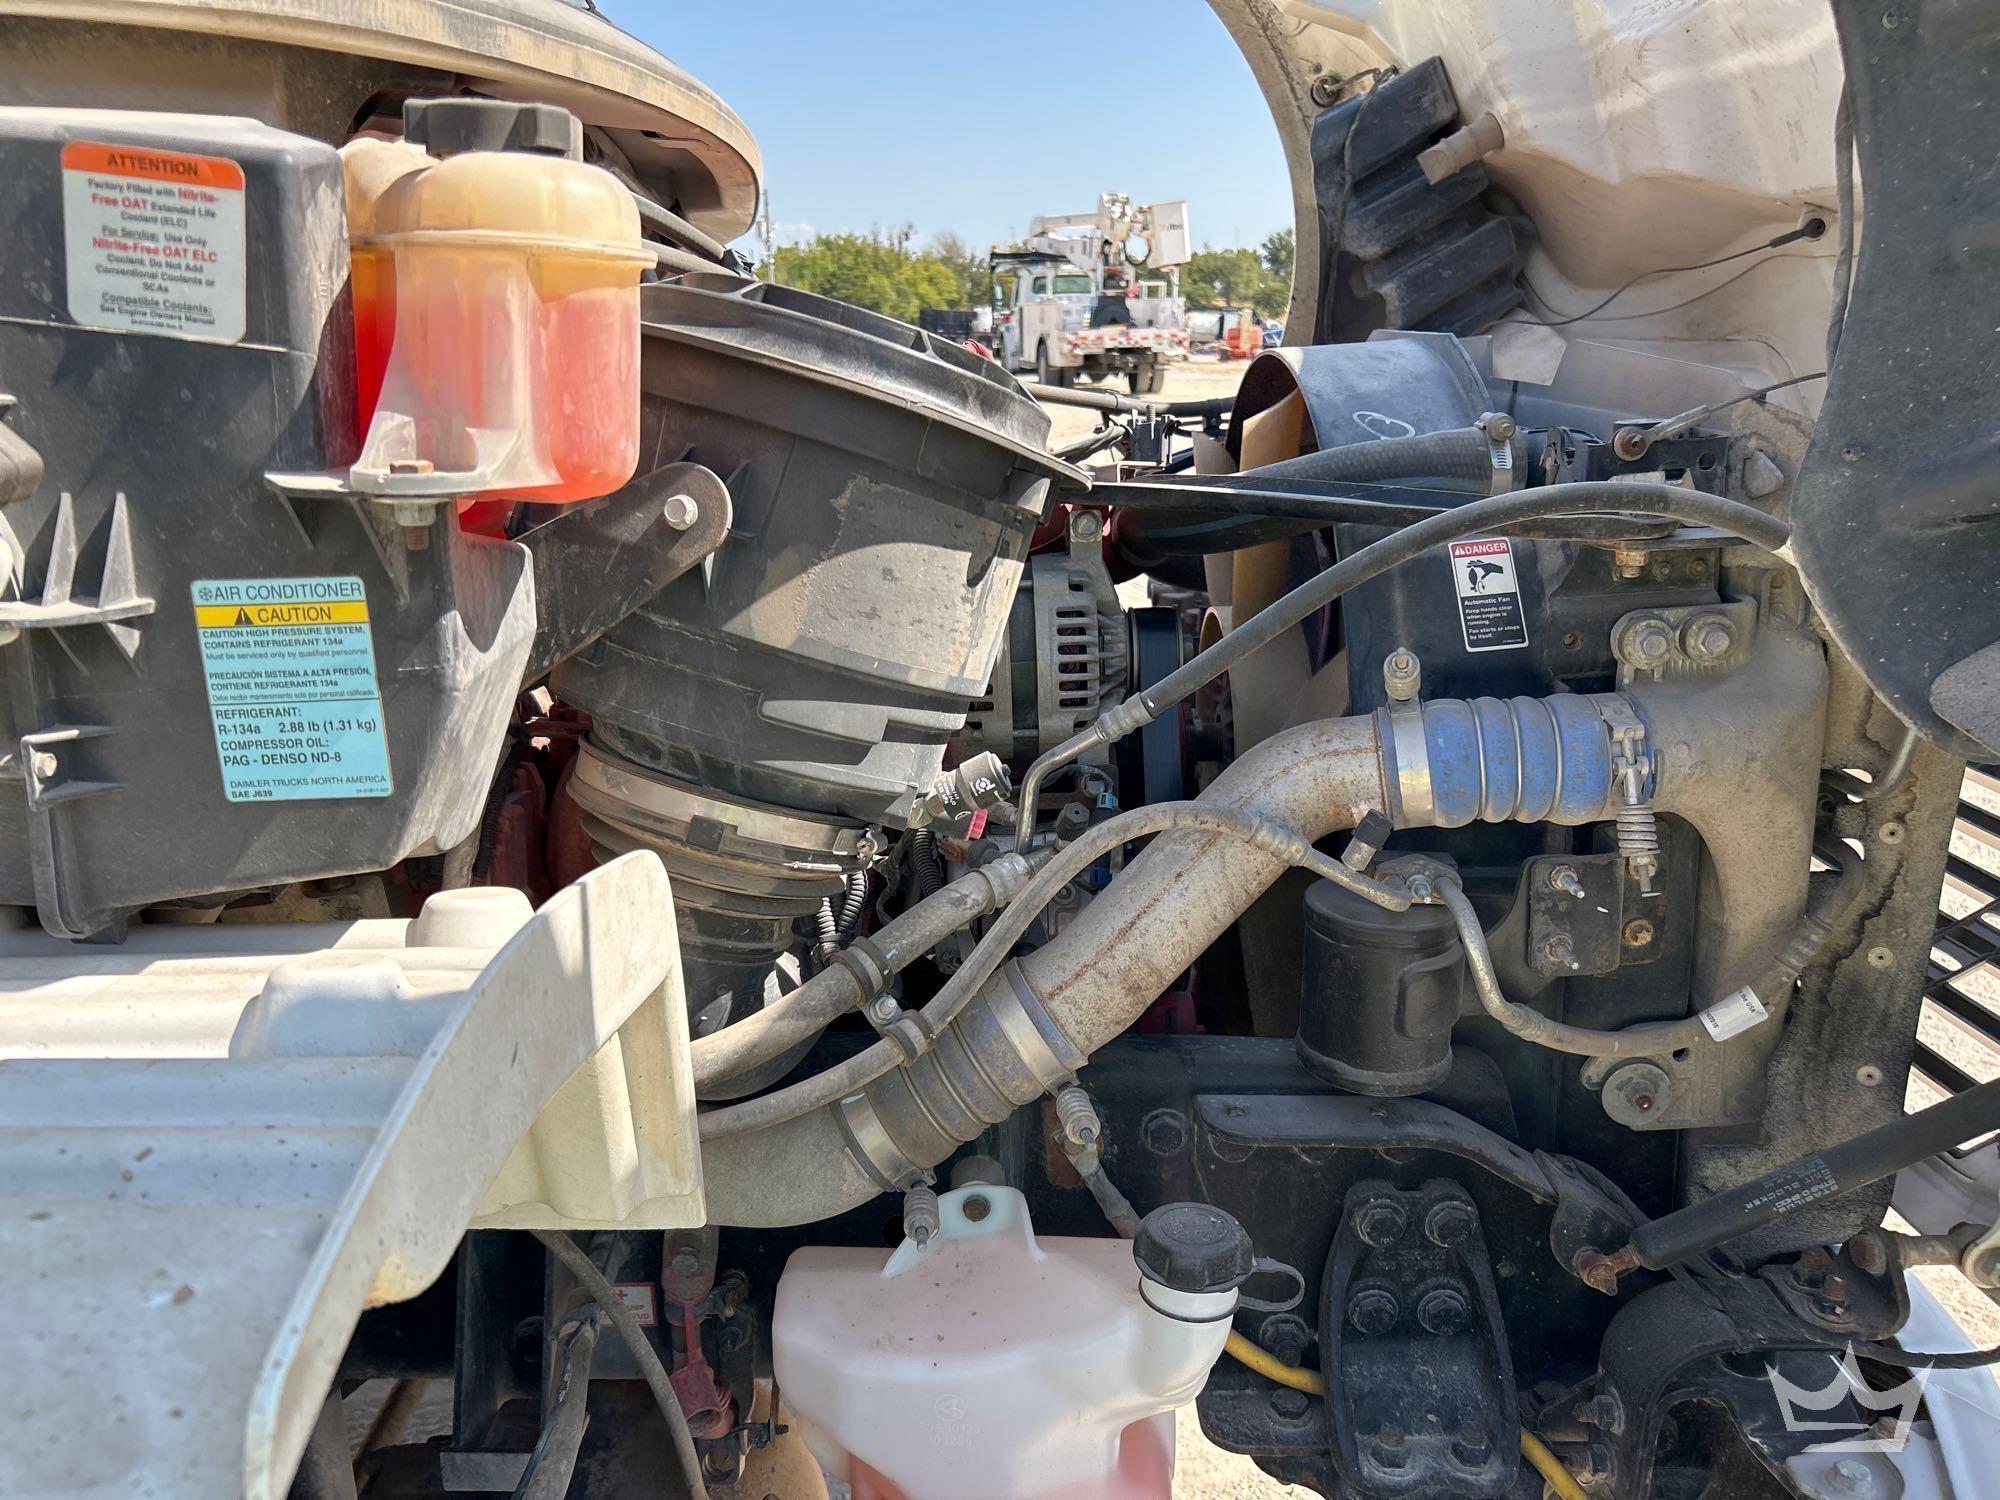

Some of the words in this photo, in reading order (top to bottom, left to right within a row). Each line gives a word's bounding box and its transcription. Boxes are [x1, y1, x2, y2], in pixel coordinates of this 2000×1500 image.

[107, 153, 198, 176] ATTENTION
[88, 178, 124, 194] Factory
[127, 183, 153, 194] Filled
[155, 187, 175, 197] with
[178, 188, 220, 203] Nitrite-
[91, 192, 118, 207] Free
[122, 196, 148, 209] OAT
[151, 202, 195, 216] Extended
[198, 206, 216, 218] Life
[121, 210, 158, 223] Coolant
[161, 215, 187, 230] (ELC)
[102, 225, 117, 236] For
[165, 231, 182, 243] Use
[185, 235, 207, 248] Only
[92, 236, 160, 255] Nitrite-Free
[163, 245, 188, 259] OAT
[192, 249, 218, 263] ELC
[149, 258, 162, 268] Do
[165, 260, 182, 271] Not
[185, 262, 204, 273] Add
[96, 264, 159, 280] Conventional
[161, 271, 203, 285] Coolants
[143, 281, 169, 293] SCAs
[102, 292, 160, 307] Compatible
[163, 299, 213, 315] Coolants:
[100, 303, 115, 313] See
[118, 306, 147, 317] Engine
[185, 313, 216, 325] Manual
[1465, 542, 1508, 555] DANGER
[214, 586, 241, 601] AIR
[246, 582, 362, 601] CONDITIONER
[1464, 598, 1497, 606] Automatic
[258, 606, 332, 623] CAUTION
[203, 629, 244, 638] CAUTION
[246, 628, 269, 638] HIGH
[272, 627, 323, 637] PRESSURE
[325, 625, 366, 635] SYSTEM,
[204, 640, 251, 650] CONTAINS
[254, 638, 320, 648] REFRIGERANT
[323, 636, 343, 646] 134a
[206, 651, 224, 660] Must
[226, 651, 235, 660] be
[237, 650, 269, 660] serviced
[271, 650, 286, 660] only
[288, 650, 297, 660] by
[299, 648, 330, 659] qualified
[209, 670, 263, 680] PRECAUCIÓN
[265, 669, 300, 679] SISTEMA
[303, 669, 309, 677] A
[311, 667, 331, 677] ALTA
[211, 682, 252, 691] CONTIENE
[254, 680, 318, 690] REFRIGERANTE
[320, 679, 338, 688] 134a
[230, 693, 247, 701] recibir
[250, 691, 293, 700] mantenimiento
[308, 691, 318, 700] por
[320, 689, 345, 699] personal
[215, 707, 302, 720] REFRIGERANT:
[218, 723, 261, 736] R-134a
[279, 721, 304, 733] 2.88
[308, 720, 319, 732] lb
[323, 719, 352, 734] (1.31
[356, 718, 376, 733] kg)
[221, 739, 303, 751] COMPRESSOR
[306, 738, 329, 748] OIL:
[223, 754, 250, 767] PAG
[261, 752, 307, 765] DENSO
[311, 751, 342, 763] ND-8
[230, 779, 270, 788] DAIMLER
[272, 777, 309, 786] TRUCKS
[311, 776, 343, 785] NORTH
[345, 774, 387, 784] AMERICA
[232, 790, 250, 798] SAE
[252, 789, 273, 797] J639
[1746, 1002, 1756, 1014] USA
[1778, 1184, 1839, 1213] STABILUS
